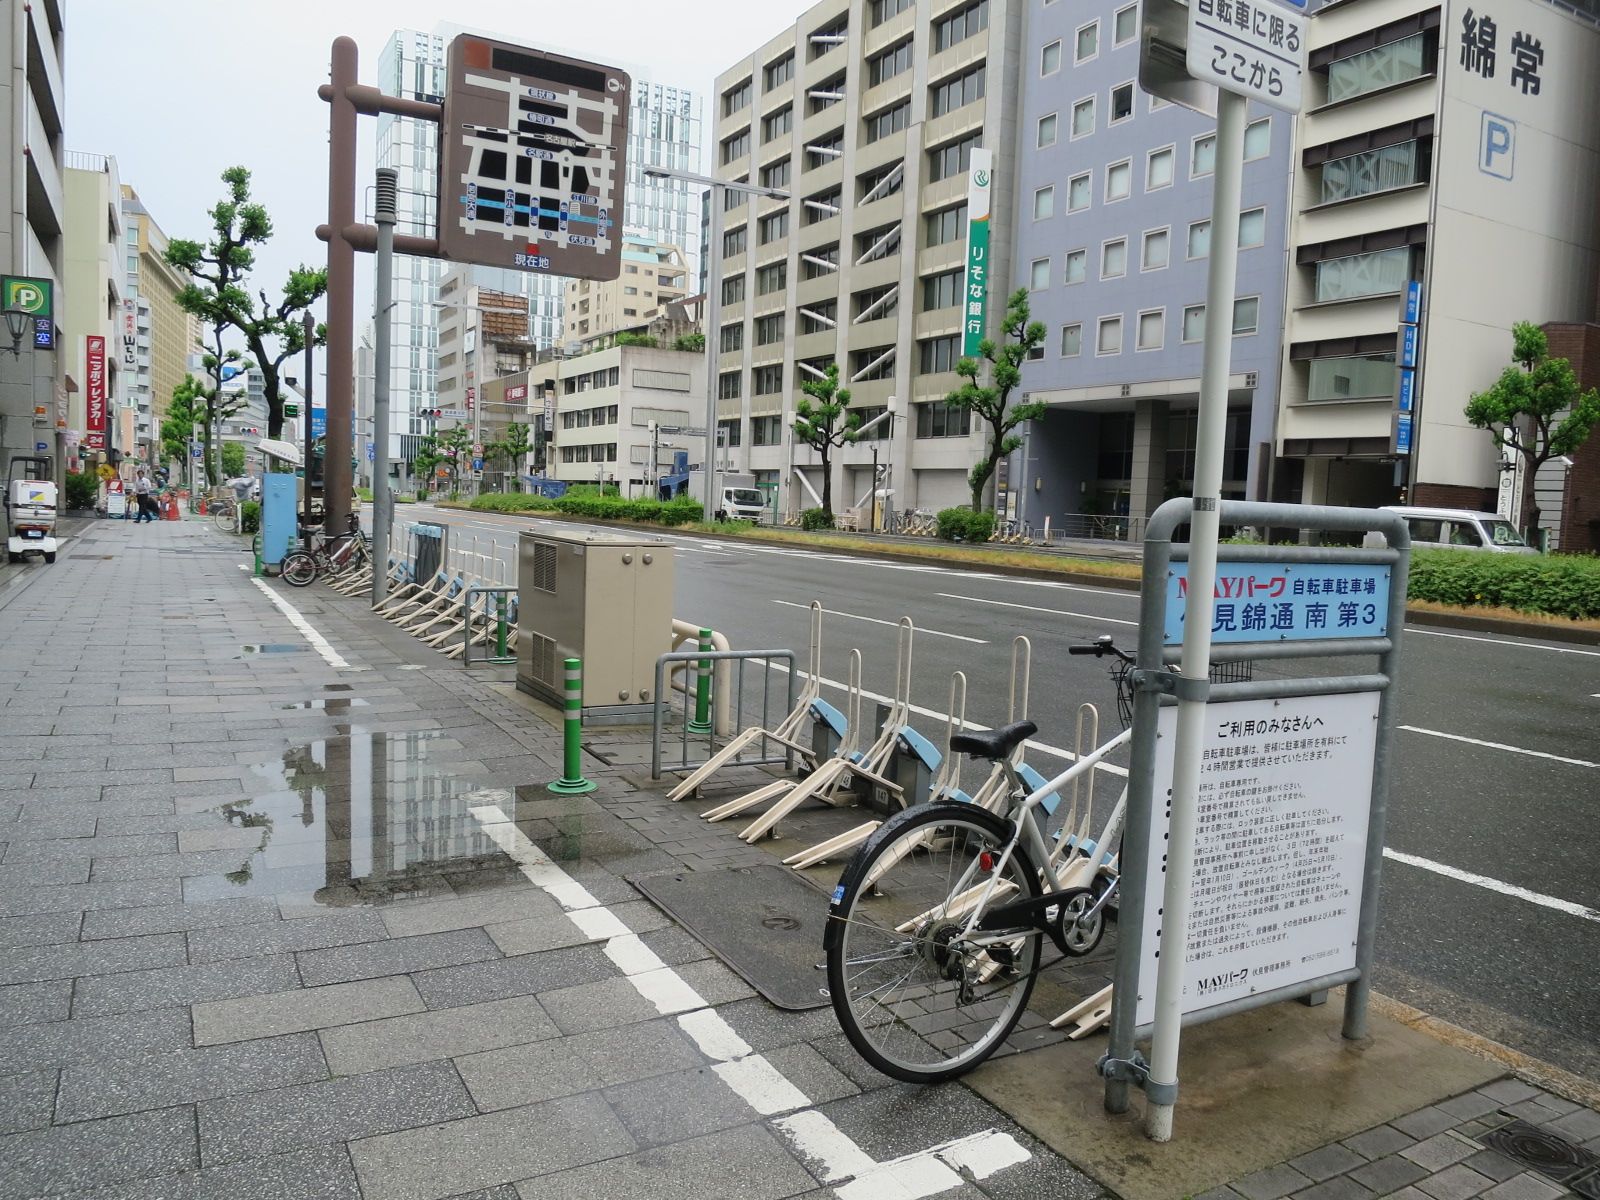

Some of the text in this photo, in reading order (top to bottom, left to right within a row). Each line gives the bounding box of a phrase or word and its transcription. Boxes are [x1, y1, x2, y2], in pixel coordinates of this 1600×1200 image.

[1198, 0, 1300, 52] 自転車に限る
[1459, 7, 1545, 97] 綿常
[1211, 45, 1283, 97] ここから
[1485, 120, 1510, 168] P
[514, 253, 549, 269] 現在地
[21, 289, 36, 306] P
[967, 246, 984, 334] りそな銀行
[36, 333, 50, 345] 空
[89, 356, 102, 426] ニッポンレンタカー
[1293, 577, 1376, 595] 自転車駐車場
[1180, 601, 1376, 632] 見錦通南第3
[1217, 715, 1324, 738] ご利用のみなさんへ
[1197, 968, 1249, 991] MAYパーク
